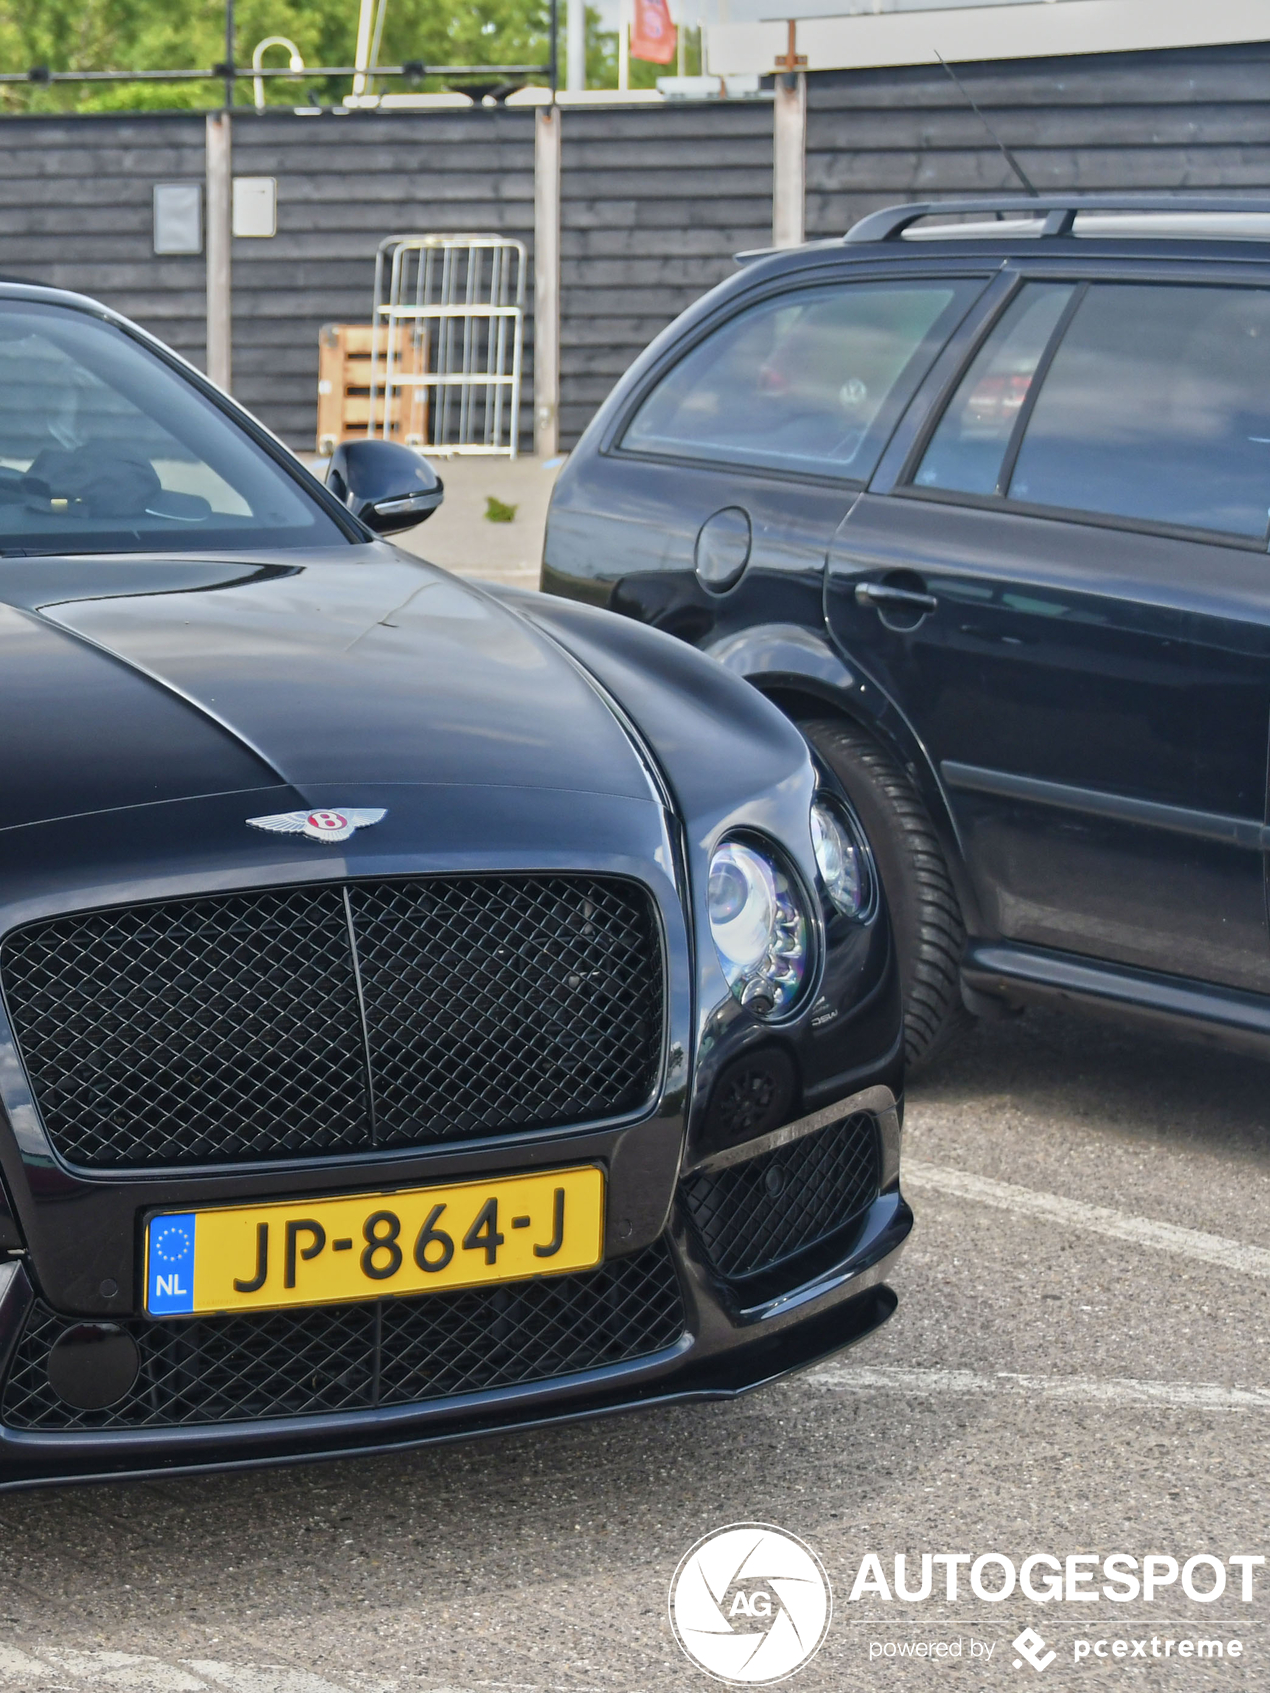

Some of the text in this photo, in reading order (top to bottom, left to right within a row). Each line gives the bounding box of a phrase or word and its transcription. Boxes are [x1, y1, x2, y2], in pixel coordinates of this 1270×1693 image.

[311, 812, 343, 830] B
[233, 1187, 566, 1293] JP-864-J
[155, 1274, 187, 1298] NL
